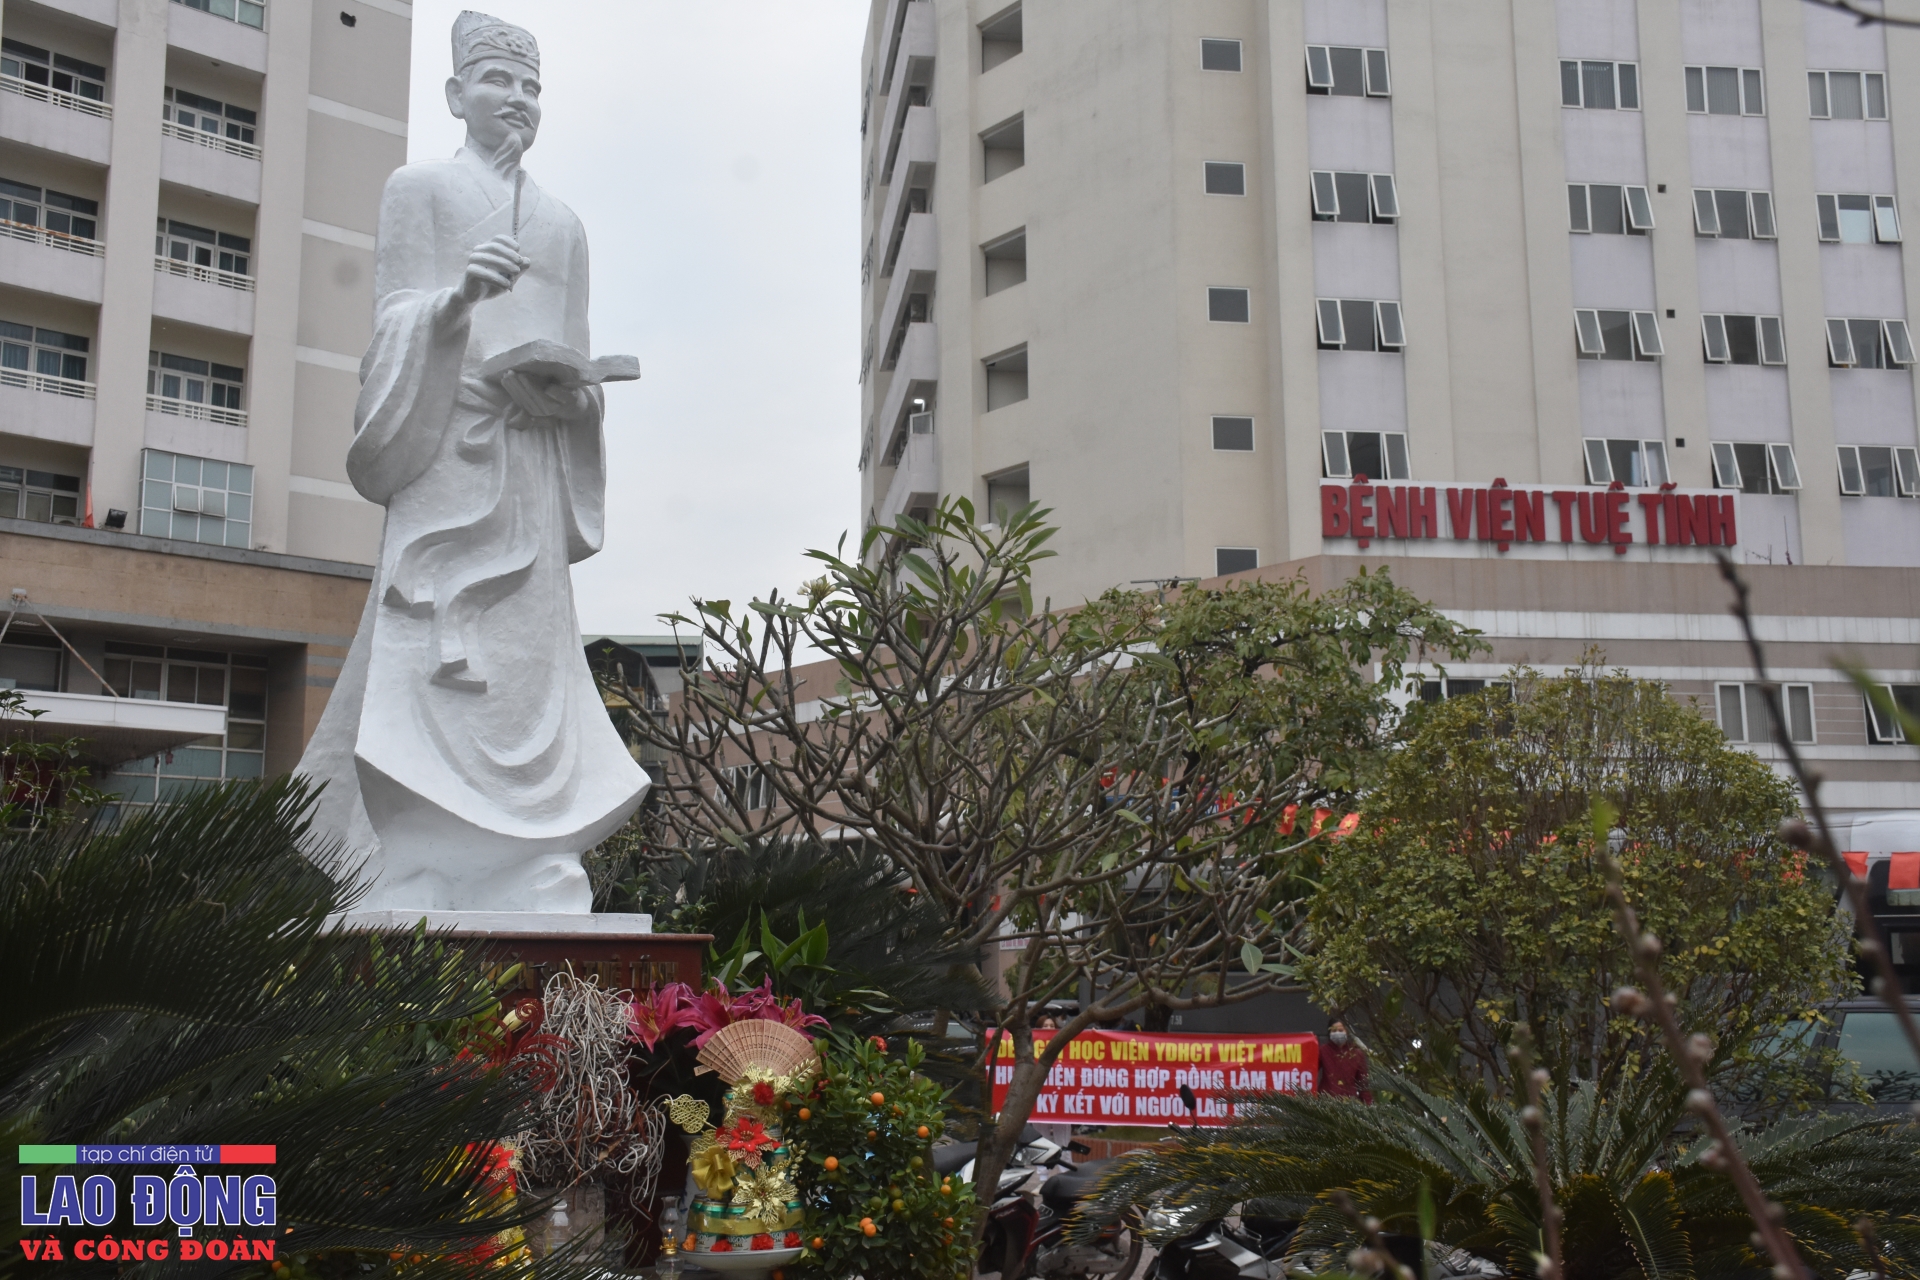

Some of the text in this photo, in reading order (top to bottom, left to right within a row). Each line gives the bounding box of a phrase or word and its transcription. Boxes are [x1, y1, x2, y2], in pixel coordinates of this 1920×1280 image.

[1321, 474, 1737, 554] BỆNH VIỆN TUỆ TĨNH
[1069, 1040, 1106, 1064] HỌC
[1110, 1038, 1150, 1065] VIỆN
[1155, 1042, 1213, 1063] YDHCT
[1218, 1040, 1257, 1066] VIỆT
[1261, 1043, 1302, 1064] NAM
[1043, 1064, 1075, 1090] IỆN
[1080, 1065, 1129, 1088] ĐÚNG
[1134, 1066, 1170, 1092] HỢP
[1175, 1063, 1225, 1090] ĐỒNG
[1230, 1067, 1266, 1090] LÀM
[1036, 1091, 1059, 1114] KÝ
[1064, 1088, 1095, 1115] KẾT
[1099, 1092, 1130, 1116] VỚI
[1136, 1093, 1190, 1117] NGƯỜ
